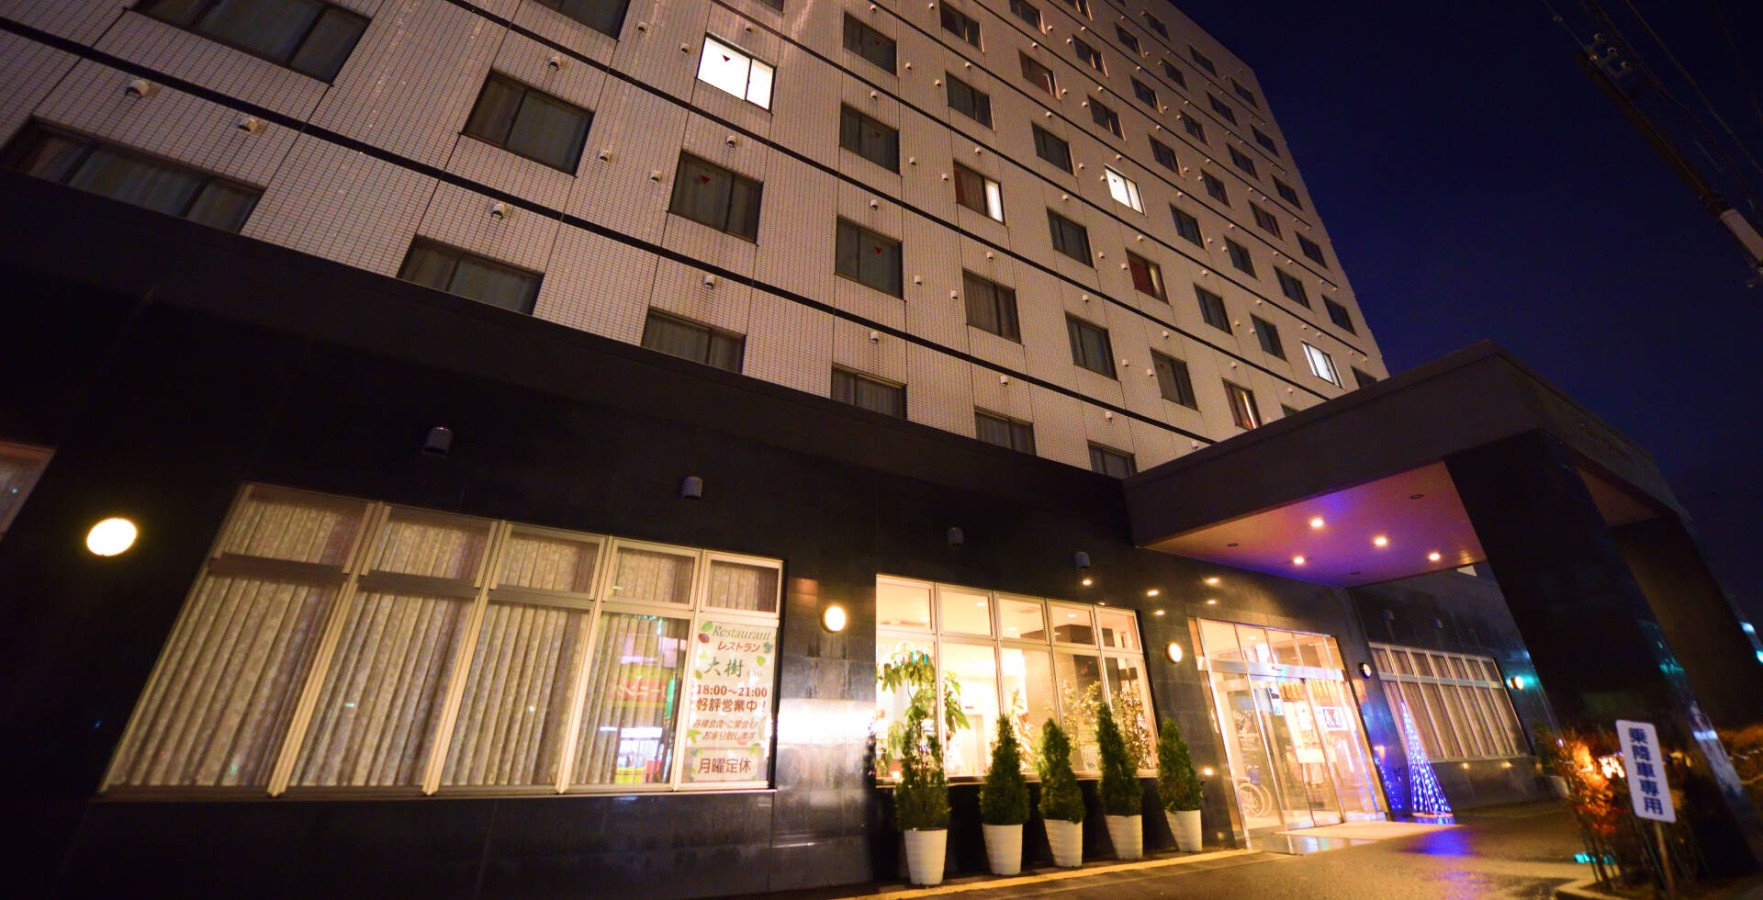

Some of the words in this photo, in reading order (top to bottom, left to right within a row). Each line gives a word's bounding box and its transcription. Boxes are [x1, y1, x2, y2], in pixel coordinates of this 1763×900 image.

[712, 625, 772, 641] Restaurant
[717, 641, 761, 653] レストラン
[704, 656, 745, 678] 大樹
[698, 757, 752, 775] 月曜定休
[1628, 727, 1664, 816] 乗降車専用
